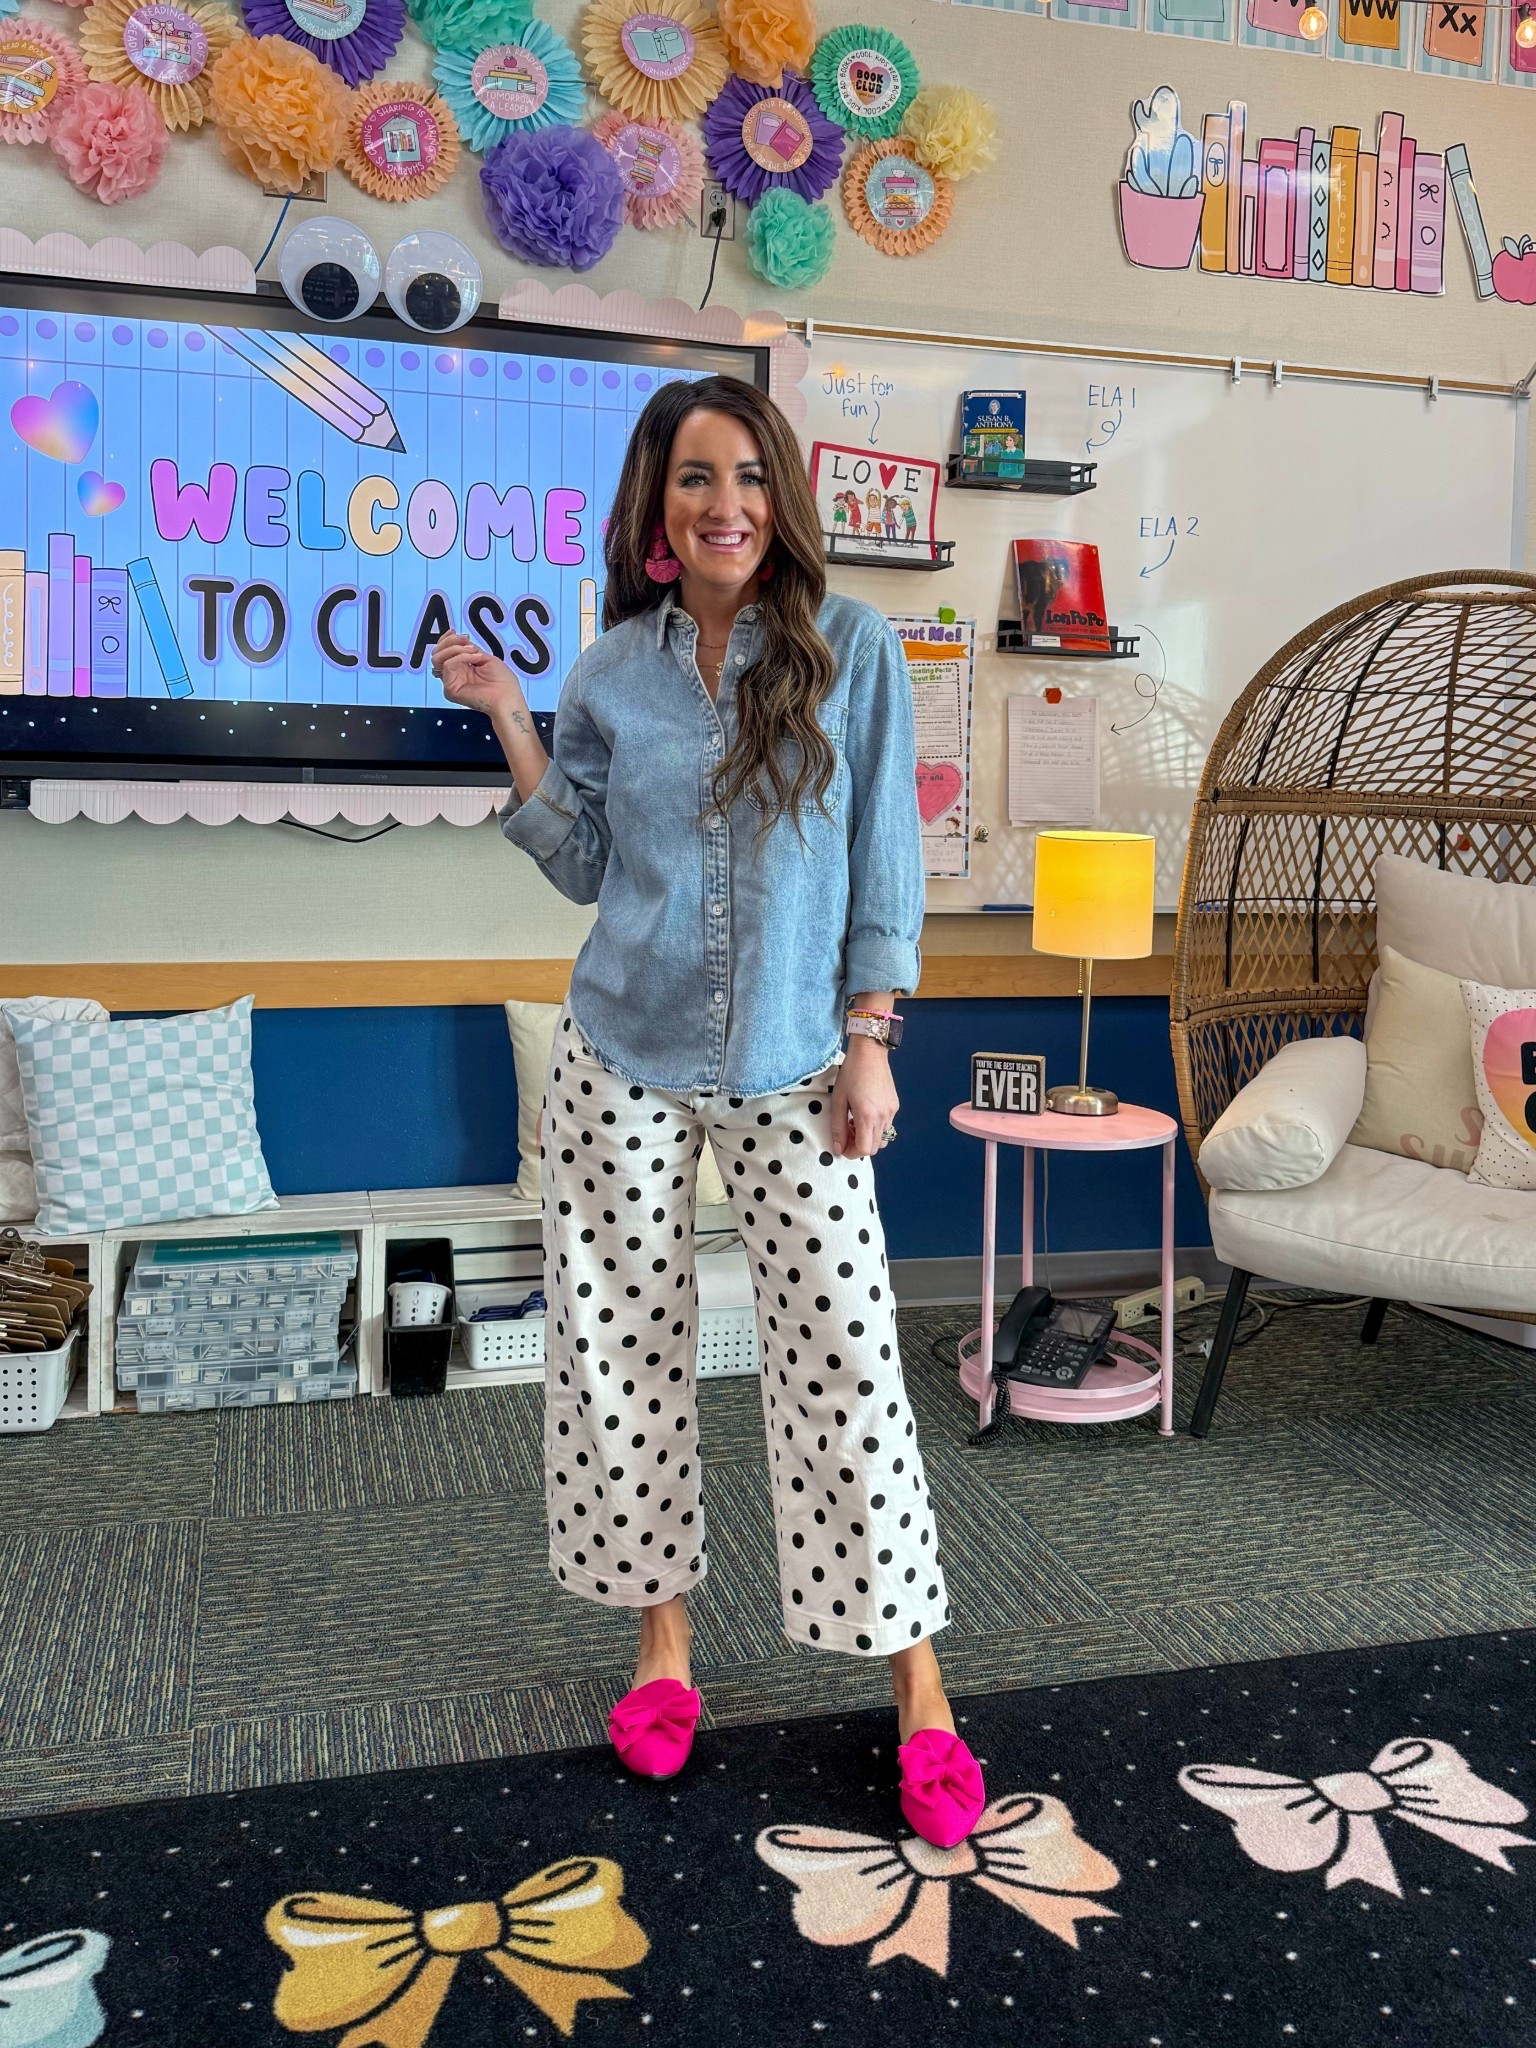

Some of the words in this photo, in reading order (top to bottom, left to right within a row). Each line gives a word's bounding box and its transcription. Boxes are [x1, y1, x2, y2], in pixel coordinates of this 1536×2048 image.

[297, 12, 347, 36] WONDERFUL
[626, 14, 646, 30] GOING
[648, 14, 677, 27] PLACES
[1439, 2, 1478, 36] Xx
[142, 6, 185, 22] READING
[186, 20, 198, 30] IS
[192, 42, 206, 67] GIFT
[2, 42, 20, 50] READ
[28, 45, 46, 58] BOOK
[128, 22, 144, 66] READING
[144, 64, 156, 74] IS
[169, 68, 190, 82] GIFT
[478, 47, 502, 64] TODAY
[514, 48, 542, 72] READER
[856, 50, 872, 58] COOL
[874, 54, 890, 67] KIDS
[640, 62, 672, 77] TURNING
[673, 54, 691, 74] PAGES
[840, 57, 853, 78] BOOKS
[856, 68, 884, 84] BOOK
[888, 66, 898, 82] READ
[840, 80, 850, 100] READ
[856, 80, 882, 94] CLUB
[884, 84, 900, 108] BOOKS
[486, 91, 534, 105] TOMORROW
[490, 102, 495, 110] A
[498, 102, 530, 114] LEADER
[847, 98, 862, 112] KIDS
[760, 100, 776, 110] OUR
[778, 101, 810, 136] FRIENDSHIP
[863, 107, 881, 115] COOL
[376, 103, 415, 117] SHARING
[416, 108, 426, 118] IS
[424, 118, 440, 153] CARING
[364, 124, 378, 156] CARING
[620, 126, 638, 142] MANY
[640, 128, 662, 140] BOOKS
[662, 138, 672, 148] TO
[670, 148, 678, 158] BE
[376, 156, 385, 166] IS
[744, 136, 756, 150] ONE
[752, 151, 766, 164] FOR
[768, 162, 780, 170] THE
[386, 162, 424, 176] SHARING
[870, 168, 881, 184] YOUR
[822, 372, 866, 395] Just
[1088, 384, 1124, 408] ELA
[1132, 387, 1136, 408] 1
[842, 398, 868, 418] fun
[150, 458, 587, 566] WELCOME
[1140, 516, 1178, 538] ELA
[1186, 516, 1200, 536] 2
[187, 577, 288, 665] TO
[313, 586, 552, 677] CLASS
[898, 626, 925, 640] out
[928, 626, 962, 642] Me!
[976, 1060, 992, 1069] YOU'RE
[994, 1061, 1003, 1070] THE
[1003, 1062, 1015, 1071] BEST
[1016, 1063, 1037, 1072] TEACHER
[976, 1069, 1037, 1112] EVER
